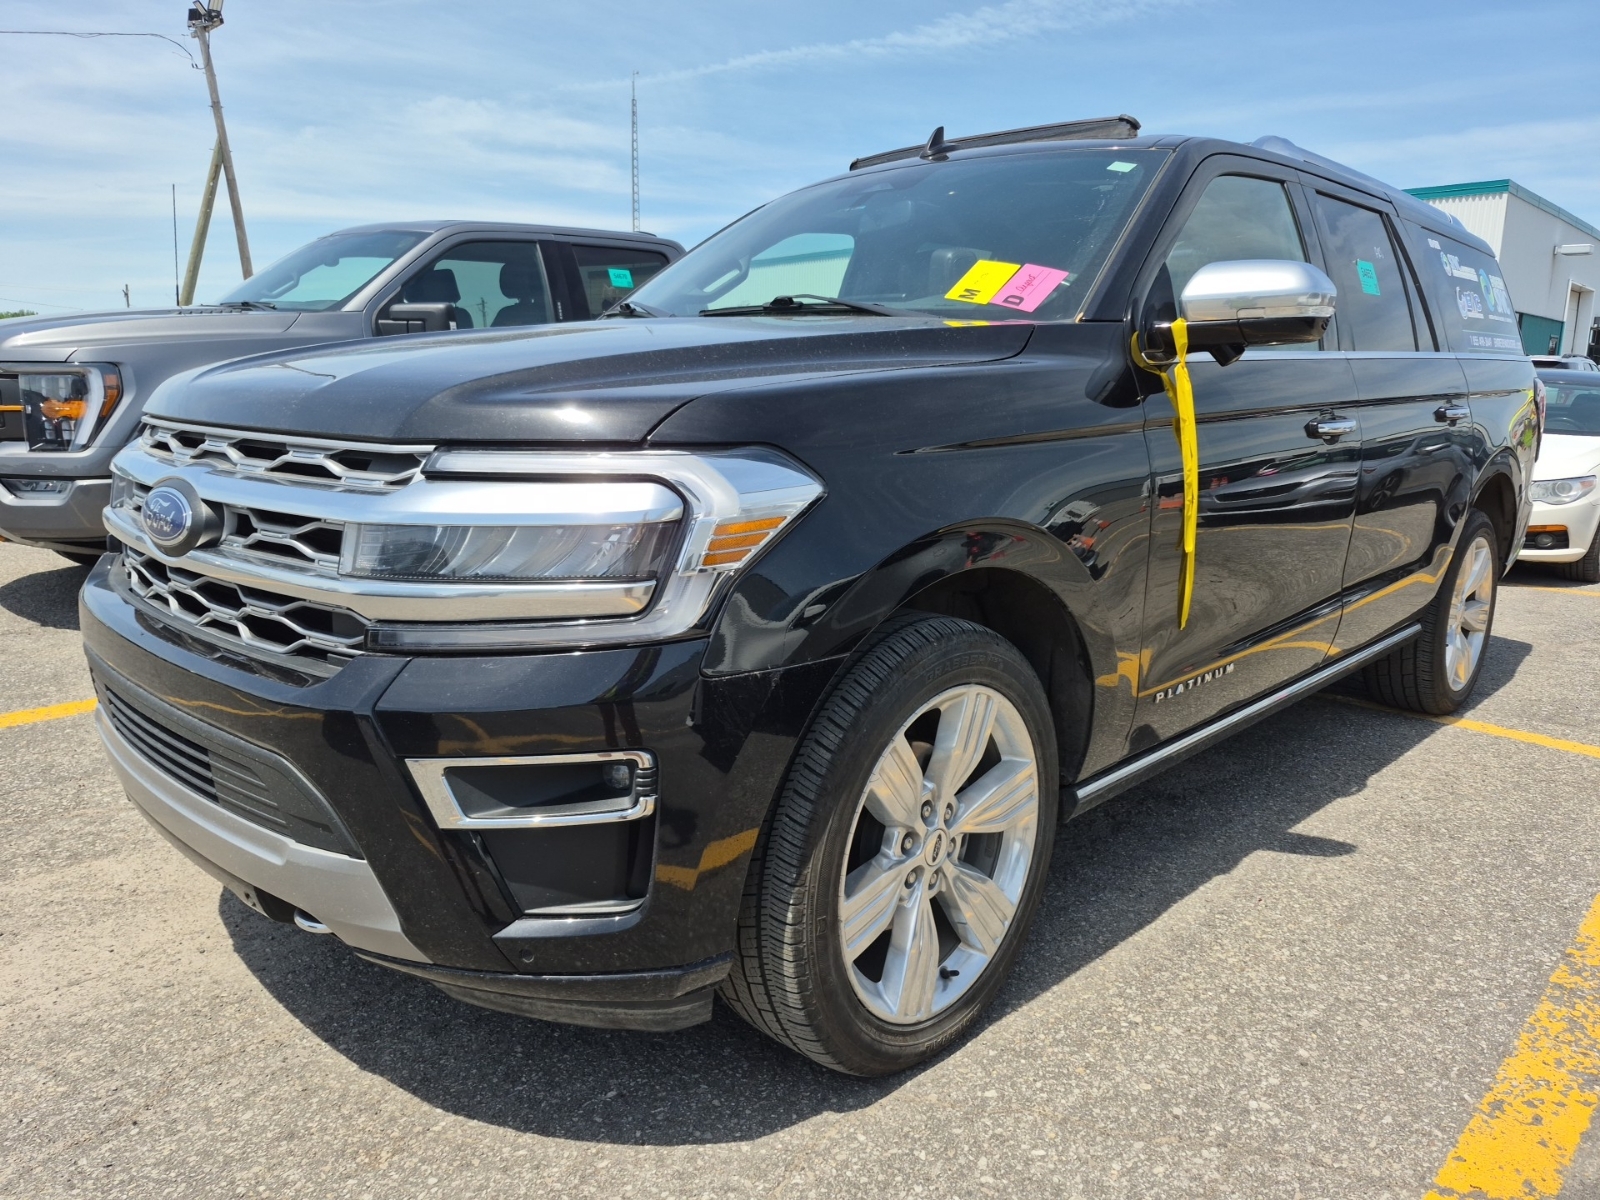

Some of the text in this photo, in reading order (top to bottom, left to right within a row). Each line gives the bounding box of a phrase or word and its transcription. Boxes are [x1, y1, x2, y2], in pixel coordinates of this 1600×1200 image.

[958, 288, 982, 300] M
[1002, 294, 1025, 307] D
[146, 497, 176, 533] Ford
[1154, 662, 1235, 704] PLATINUM
